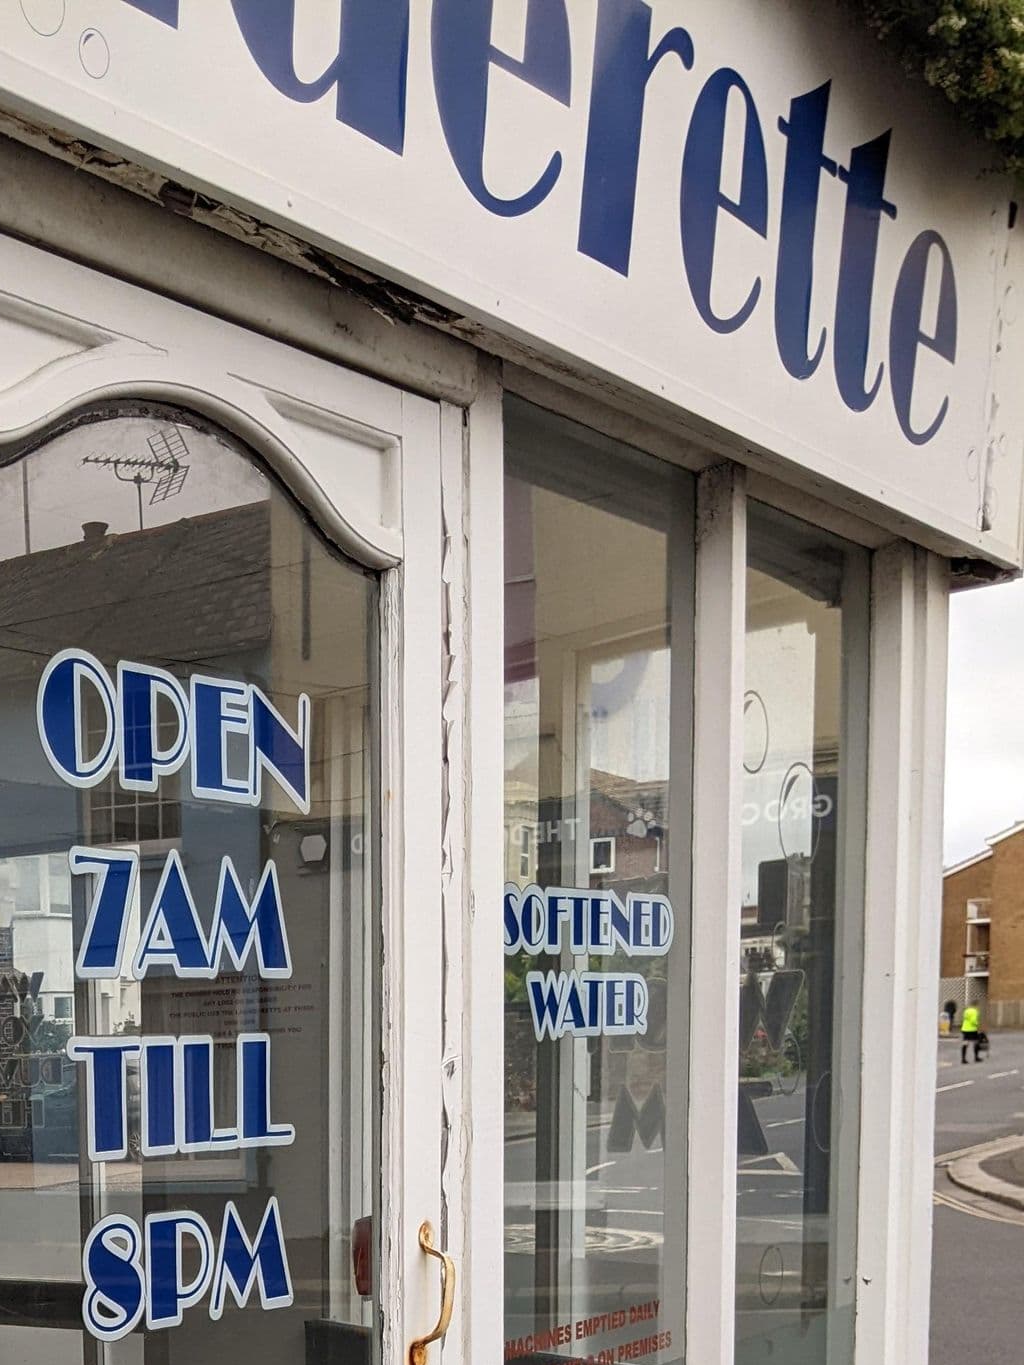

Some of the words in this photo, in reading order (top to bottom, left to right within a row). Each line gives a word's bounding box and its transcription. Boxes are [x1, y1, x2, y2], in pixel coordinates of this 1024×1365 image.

[37, 648, 311, 815] OPEN
[69, 845, 292, 981] 7AM
[504, 882, 674, 957] SOFTENED
[526, 969, 649, 1041] WATER
[67, 1033, 296, 1162] TILL
[82, 1196, 294, 1343] 8PM
[505, 1324, 572, 1361] MACHINES
[576, 1310, 626, 1340] EMPTIED
[629, 1299, 660, 1324] DAILY
[618, 1330, 673, 1362] PREMISES
